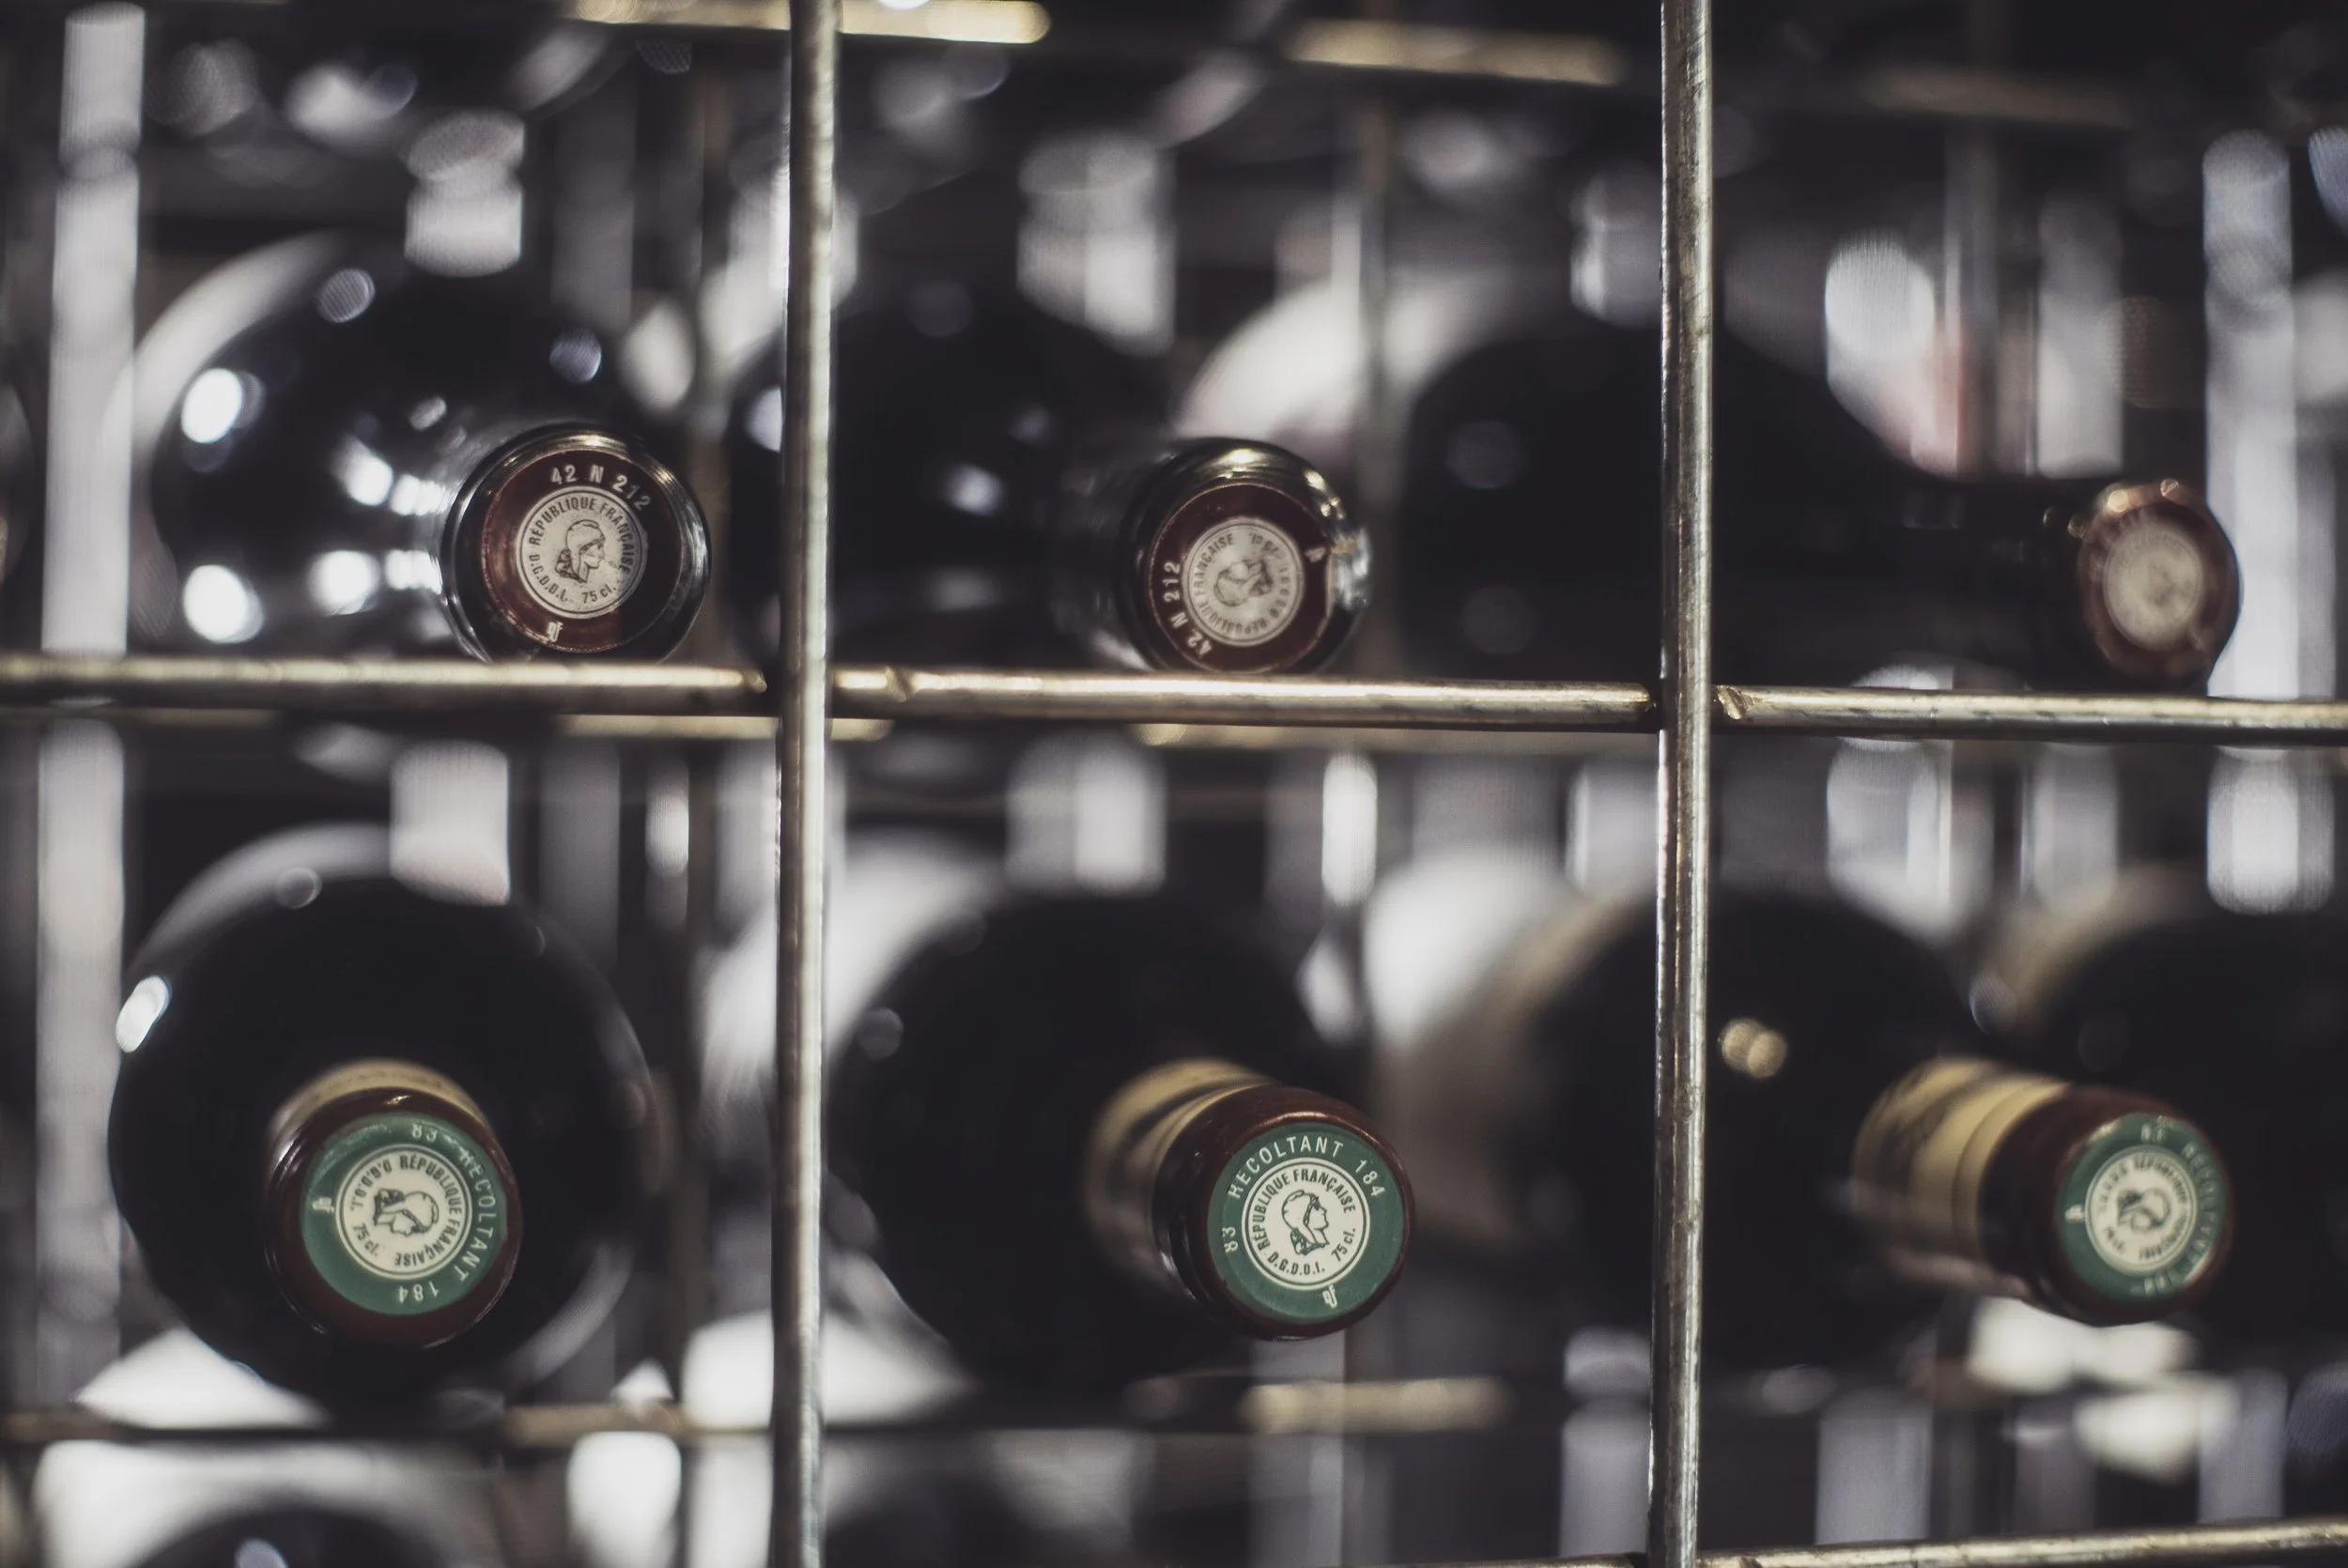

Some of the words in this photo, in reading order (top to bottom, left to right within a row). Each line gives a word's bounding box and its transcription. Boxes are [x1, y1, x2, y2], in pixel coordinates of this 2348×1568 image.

[551, 465, 577, 484] 42
[590, 465, 604, 484] N
[612, 474, 652, 511] 212
[581, 589, 598, 604] 75
[1163, 561, 1181, 603] 212
[1170, 611, 1189, 629] N
[1186, 628, 1213, 657] 42
[411, 1124, 438, 1142] 83
[1228, 1135, 1344, 1200] RECOLTANT
[1354, 1160, 1385, 1197] 184
[399, 1154, 462, 1214] RÉPUBLIQUE
[1252, 1171, 1290, 1251] RÉPUBLIQUE
[1293, 1168, 1355, 1214] FRANÇAISE
[352, 1222, 370, 1242] 75
[394, 1219, 462, 1267] FRANÇAISE
[1222, 1226, 1239, 1253] 83
[1331, 1244, 1348, 1262] 75
[398, 1281, 440, 1304] 184
